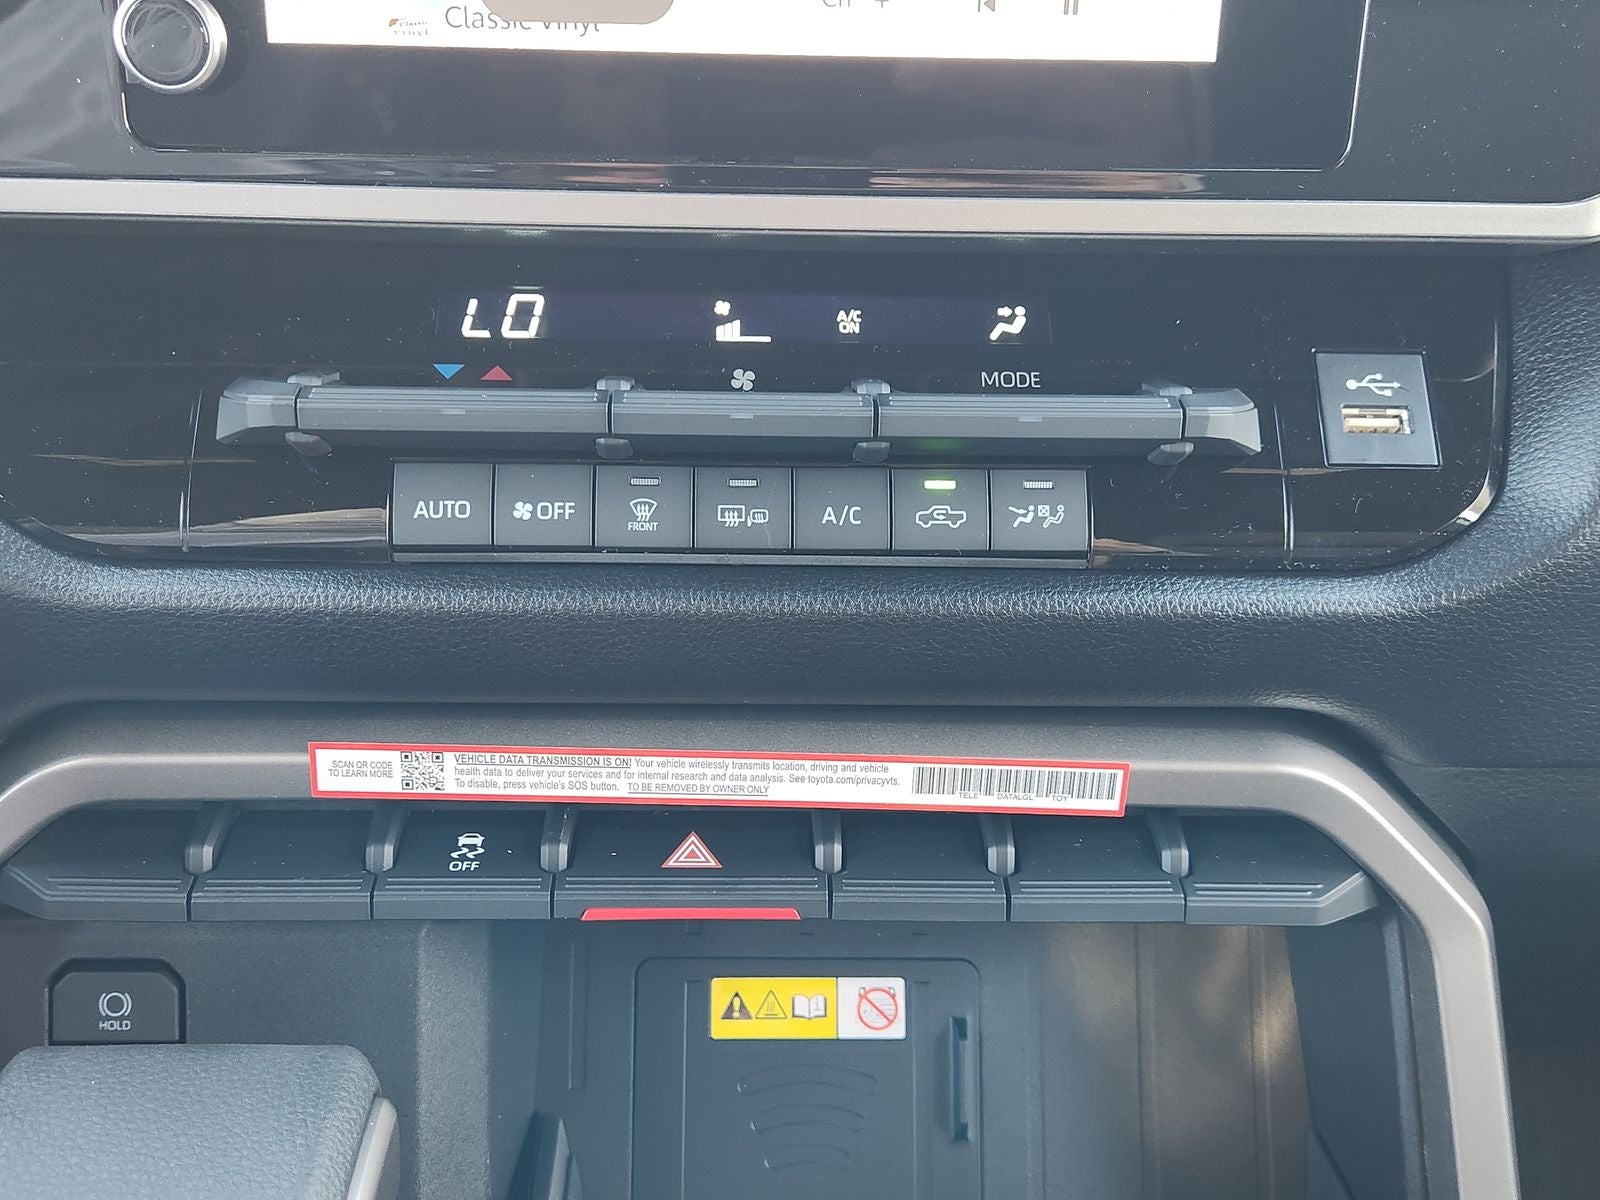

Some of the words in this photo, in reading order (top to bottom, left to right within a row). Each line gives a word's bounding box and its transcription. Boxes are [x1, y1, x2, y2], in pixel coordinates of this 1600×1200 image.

[836, 309, 862, 323] A/C
[838, 321, 860, 334] ON
[981, 371, 1041, 388] MODE
[413, 500, 471, 519] AUTO
[536, 501, 576, 520] OFF
[821, 505, 862, 526] A/C
[628, 521, 659, 532] FRONT
[332, 760, 354, 769] SCAN
[356, 760, 368, 770] QR
[369, 761, 393, 770] CODE
[454, 754, 496, 765] VEHICLE
[499, 755, 524, 765] DATA
[526, 755, 600, 767] TRANSMISSION
[602, 757, 612, 767] IS
[635, 758, 655, 769] Your
[656, 758, 686, 769] vehicle
[688, 759, 729, 771] wirelessly
[732, 760, 770, 771] transmits
[772, 761, 807, 772] location,
[810, 762, 838, 773] driving
[841, 763, 857, 773] and
[859, 763, 889, 773] vehicle
[328, 768, 339, 777] TO
[341, 769, 368, 778] LEARN
[369, 769, 394, 778] MORE
[454, 766, 481, 777] health
[483, 767, 501, 777] data
[504, 768, 513, 777] to
[516, 768, 544, 778] deliver
[547, 770, 565, 780] your
[567, 769, 602, 780] services
[605, 769, 621, 779] and
[623, 769, 635, 780] for
[637, 770, 669, 781] internal
[671, 771, 708, 781] research
[710, 771, 726, 782] and
[728, 772, 747, 782] data
[749, 773, 786, 784] analysis.
[788, 773, 805, 783] See
[455, 778, 465, 788] To
[467, 778, 500, 790] disable,
[503, 780, 527, 791] press
[528, 780, 565, 790] vehicle's
[567, 780, 588, 791] SOS
[590, 781, 619, 792] button.
[628, 782, 640, 792] TO
[641, 782, 652, 792] BE
[655, 783, 698, 793] REMOVED
[700, 784, 711, 793] BY
[712, 784, 745, 794] OWNER
[747, 784, 770, 795] ONLY
[958, 791, 979, 799] TELE
[1051, 794, 1069, 802] TOY
[449, 861, 480, 871] OFF
[98, 1020, 131, 1031] HOLD
